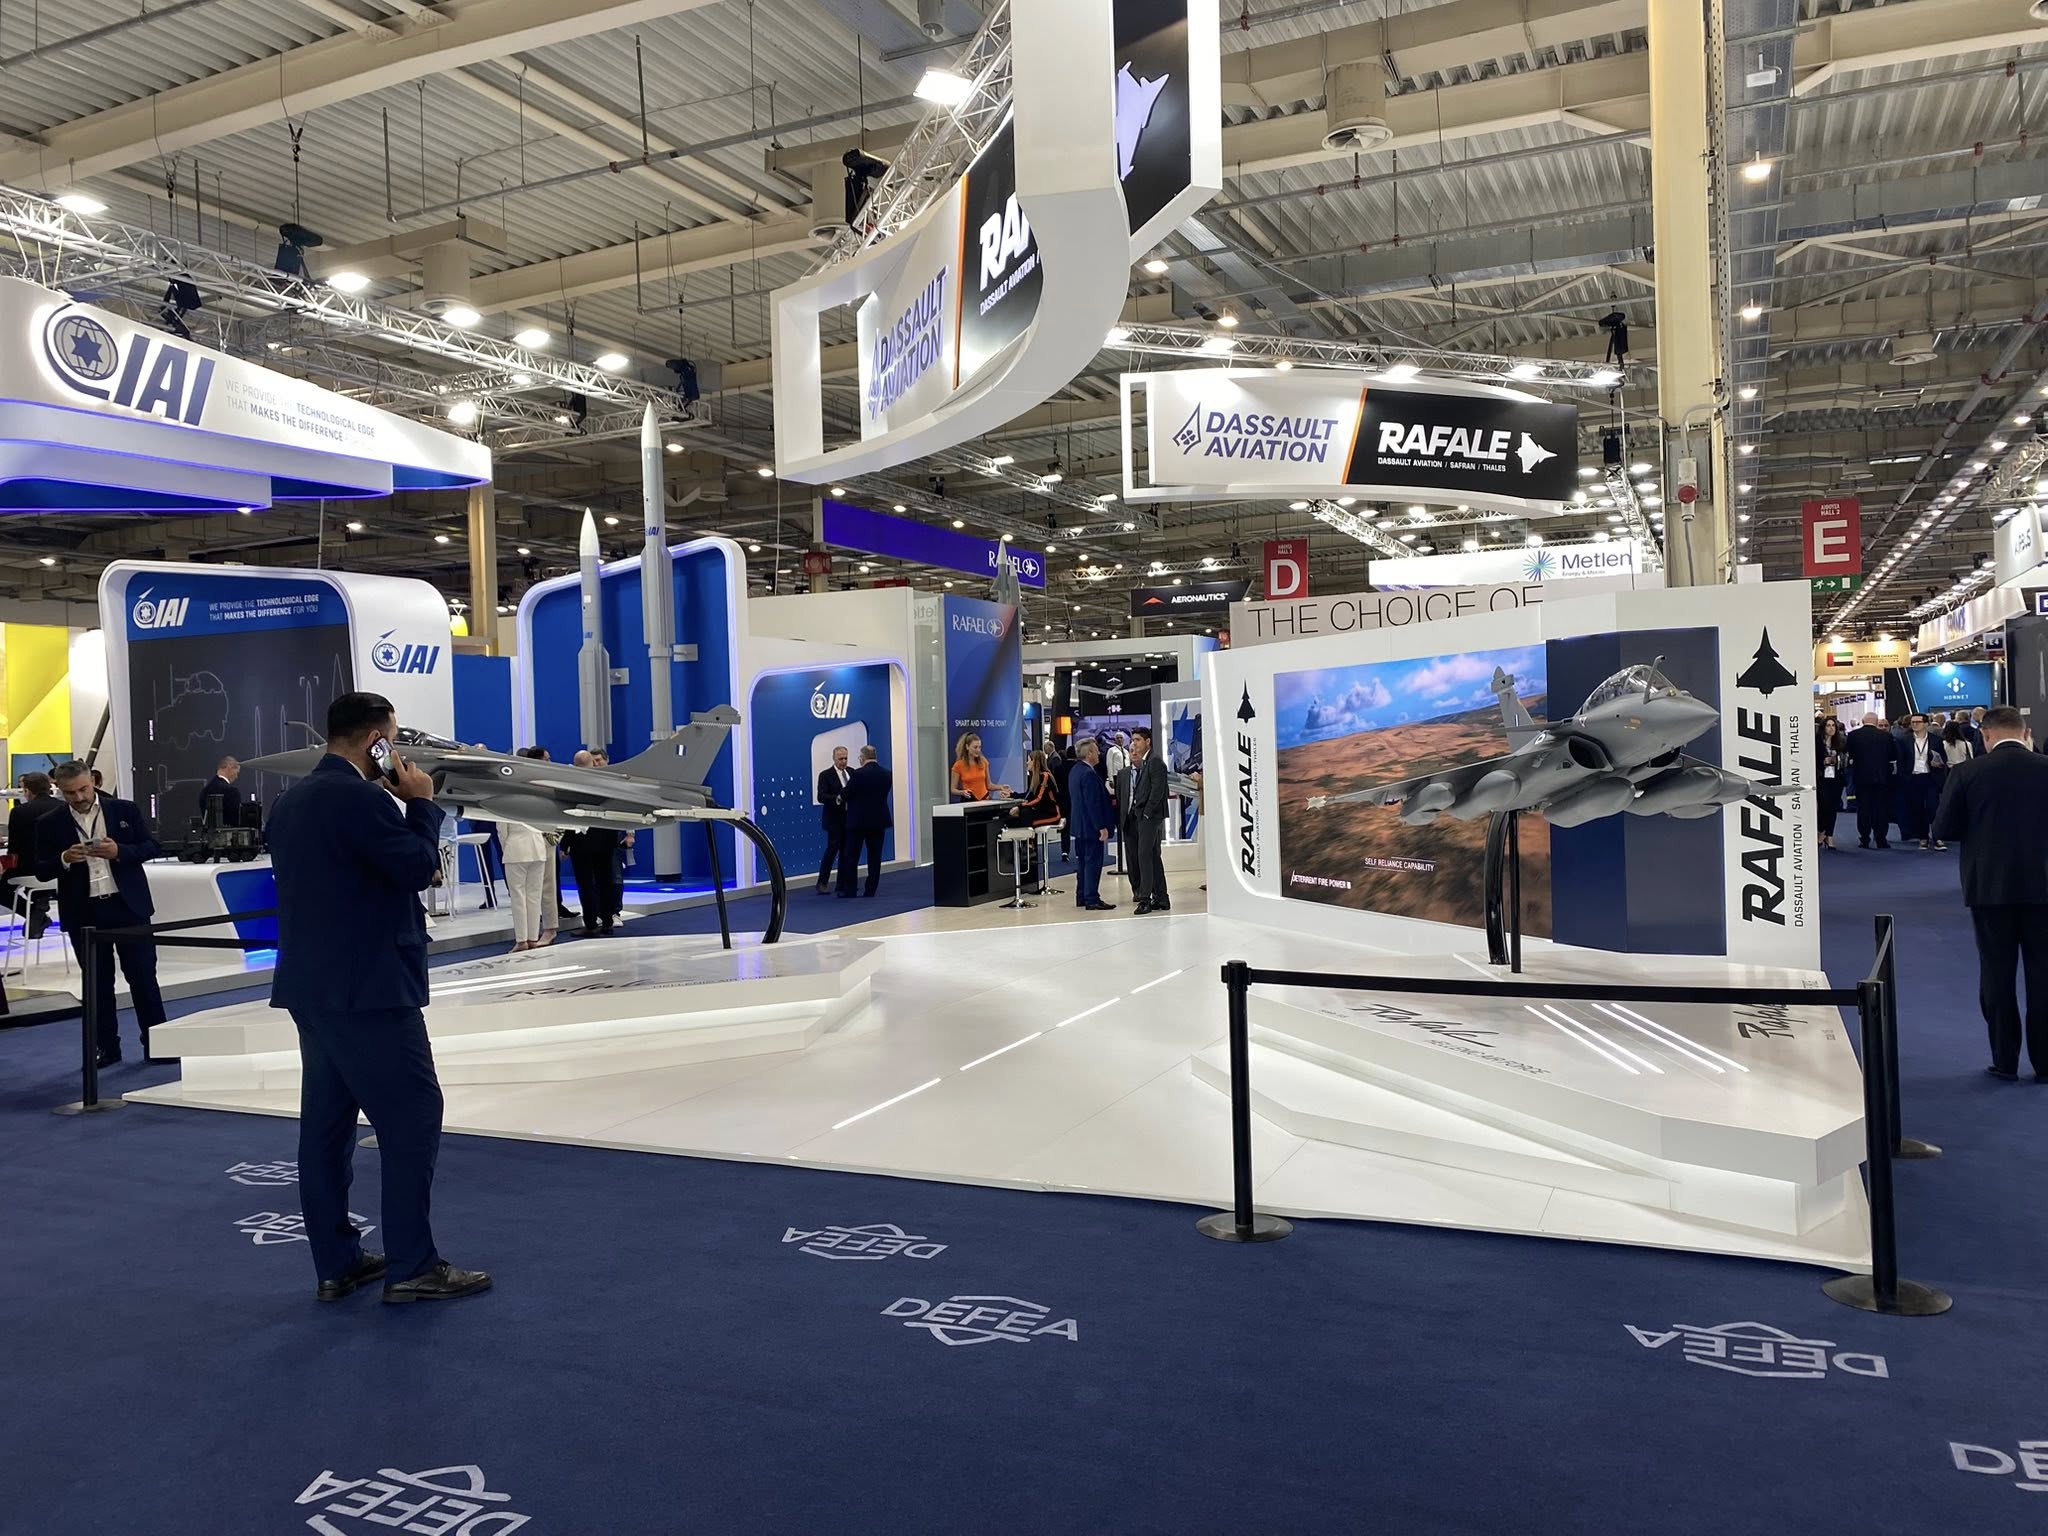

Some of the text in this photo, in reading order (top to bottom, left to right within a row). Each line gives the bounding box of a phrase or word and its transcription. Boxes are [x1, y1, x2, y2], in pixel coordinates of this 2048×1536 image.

[979, 191, 1030, 291] RA
[979, 279, 1009, 316] DASSAULT
[1008, 253, 1036, 291] AVIATION
[880, 264, 947, 375] DASSAULT
[113, 333, 216, 426] IAI
[880, 316, 943, 413] AVIATION
[225, 379, 240, 393] WE
[242, 384, 277, 405] PROVIDE
[296, 402, 356, 431] TECHNOLOGICAL
[357, 423, 375, 438] EDGE
[226, 396, 344, 442] THAT MAKES THE DIFFERENCE
[1204, 436, 1328, 463] AVIATION
[1205, 411, 1512, 460] DASSAULT RAFALE
[1377, 457, 1411, 466] DASSAULT
[1413, 458, 1443, 468] AVIATION
[1450, 461, 1476, 470] SAFRAN
[1482, 463, 1506, 472] THALES
[1562, 552, 1632, 570] Metlen
[1813, 519, 1850, 564] E
[1270, 558, 1301, 596] D
[153, 597, 190, 628] IAI
[208, 594, 319, 611] WE PROVIDE THE TECHNOLOGICAL EDGE
[209, 604, 319, 621] THAT MAKES THE DIFFERENCE FOR YOU
[952, 614, 988, 634] RAFAEL
[1248, 603, 1319, 637] THE
[1329, 590, 1476, 632] CHOICE
[397, 644, 441, 674] IAI
[826, 693, 851, 718] IAI
[1790, 715, 1799, 756] THALES
[1237, 731, 1256, 877] RAFALE
[1364, 857, 1435, 872] SELF RELIANCE CAPABILITY
[1793, 823, 1802, 871] AVIATION
[1794, 874, 1804, 927] DASSAULT
[781, 1226, 949, 1260] DEFEA
[879, 1296, 1079, 1342] DEFEA
[1622, 1323, 1890, 1379] DEFEA
